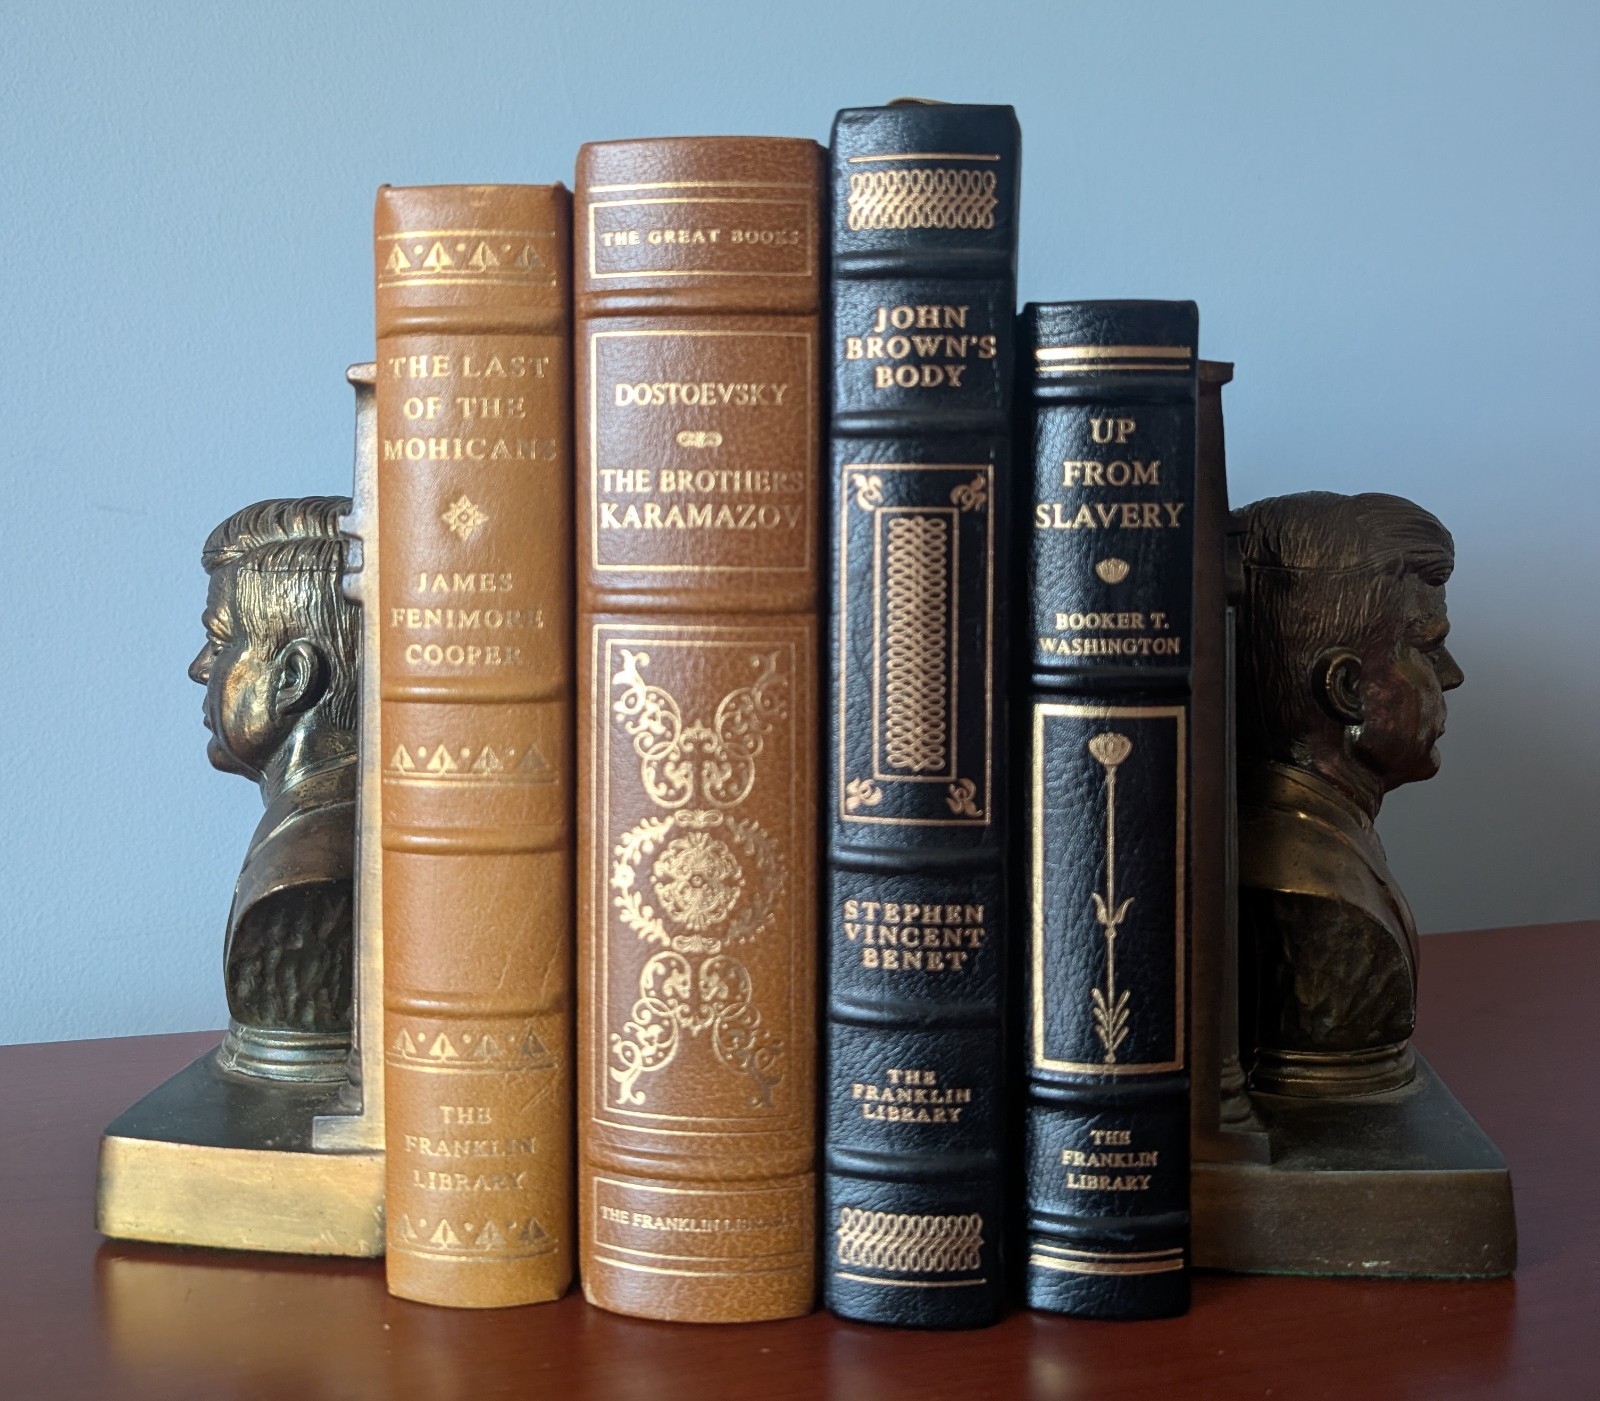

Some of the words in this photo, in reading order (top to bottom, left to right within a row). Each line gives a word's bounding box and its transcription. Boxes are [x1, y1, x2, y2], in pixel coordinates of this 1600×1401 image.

[602, 231, 641, 247] THE
[648, 229, 721, 245] GREAT
[731, 229, 800, 245] BOOKS
[873, 305, 970, 333] JOHN
[846, 335, 997, 359] BROWN'S
[389, 355, 450, 379] THE
[462, 355, 549, 379] LAST
[875, 364, 967, 389] BODY
[615, 382, 788, 406] DOSTOEVSKY
[403, 397, 441, 420] OF
[456, 397, 526, 420] THE
[1091, 418, 1136, 443] UP
[383, 438, 557, 461] MOHICANS
[600, 468, 652, 493] THE
[659, 469, 805, 493] BROTHERS
[1062, 460, 1161, 487] FROM
[600, 502, 803, 530] KARAMAZOV
[1035, 503, 1184, 528] SLAVERY
[418, 572, 513, 593] JAMES
[390, 607, 545, 630] FENIMORE
[1055, 612, 1145, 630] BOOKER
[1150, 612, 1170, 629] T.
[405, 644, 522, 667] COOPER
[1039, 637, 1181, 655] WASHINGTON
[843, 900, 984, 925] STEPHEN
[844, 923, 985, 948] VINCENT
[862, 948, 968, 972] BENET
[886, 1068, 937, 1086] THE
[852, 1083, 972, 1105] FRANKLIN
[440, 1106, 492, 1125] THE
[862, 1103, 963, 1124] LIBRARY
[404, 1134, 536, 1158] FRANKLIN
[1089, 1129, 1131, 1145] THE
[1060, 1150, 1158, 1168] FRANKLIN
[412, 1169, 527, 1191] LIBRARY
[1066, 1172, 1151, 1191] LIBRARY
[600, 1205, 629, 1225] THE
[631, 1212, 721, 1233] FRANKLIN
